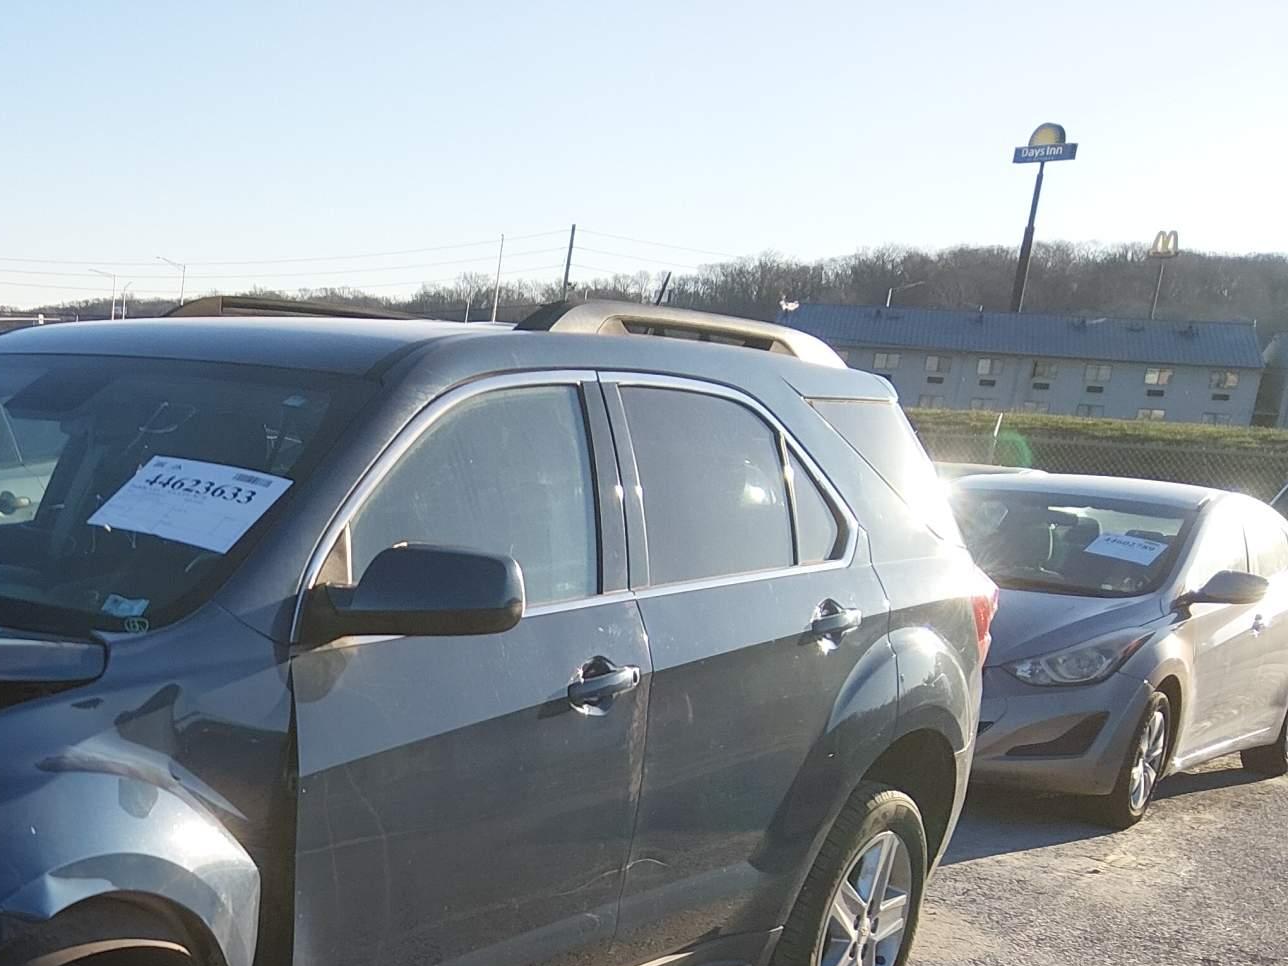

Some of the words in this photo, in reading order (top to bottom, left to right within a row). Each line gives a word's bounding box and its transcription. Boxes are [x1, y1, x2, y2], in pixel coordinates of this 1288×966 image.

[1021, 147, 1045, 158] Days
[1046, 146, 1063, 156] Inn
[145, 473, 257, 505] 44623633
